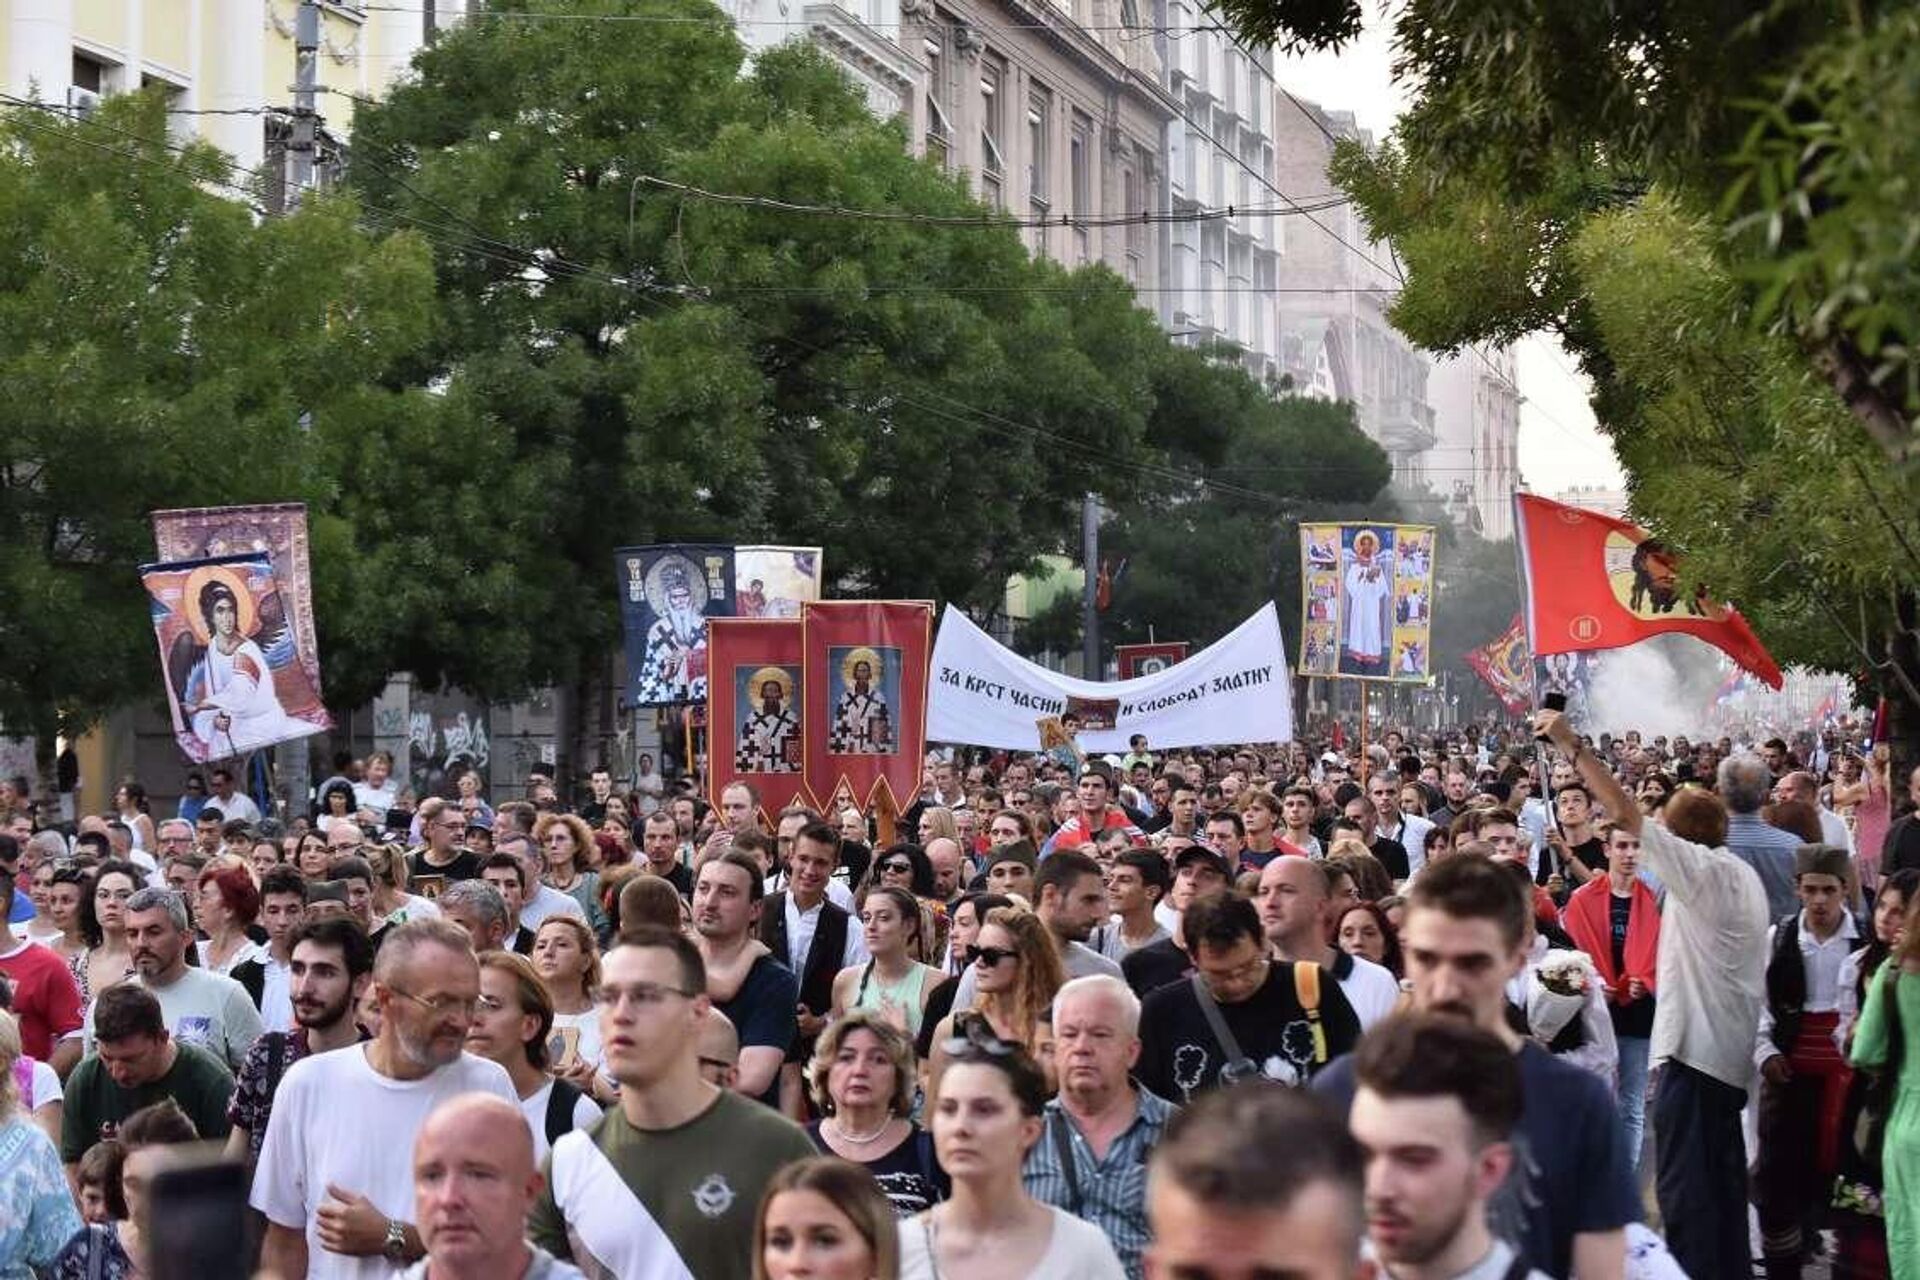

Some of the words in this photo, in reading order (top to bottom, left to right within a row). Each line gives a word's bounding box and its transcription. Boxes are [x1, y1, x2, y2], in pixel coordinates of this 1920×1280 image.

[940, 667, 960, 686] ЗА
[965, 675, 1006, 701] КРСТ
[1010, 689, 1062, 714] ЧАСНИ
[1122, 704, 1134, 716] И
[1137, 682, 1208, 713] СЛОБОДУ
[1212, 665, 1272, 694] ЗЛАТНУ
